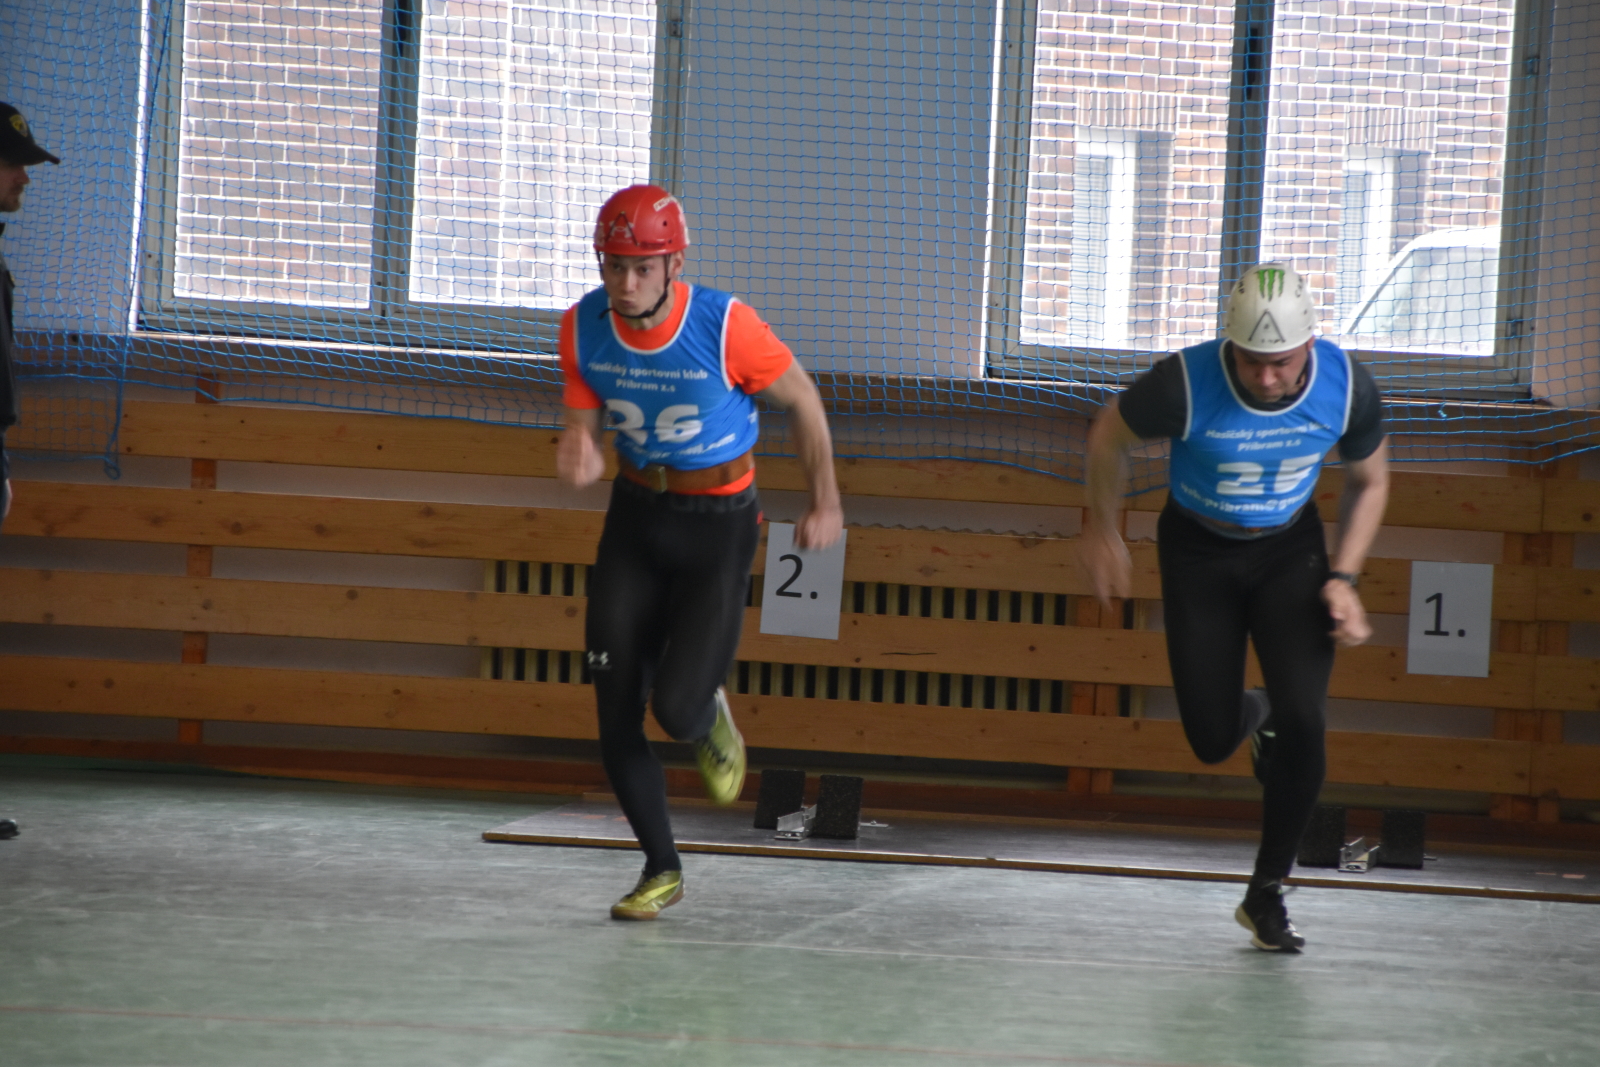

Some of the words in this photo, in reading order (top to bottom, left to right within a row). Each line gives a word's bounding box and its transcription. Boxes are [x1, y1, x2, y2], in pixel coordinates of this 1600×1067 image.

[682, 368, 709, 379] klub
[604, 399, 704, 445] 26
[775, 553, 818, 600] 2.
[1424, 592, 1466, 638] 1.
